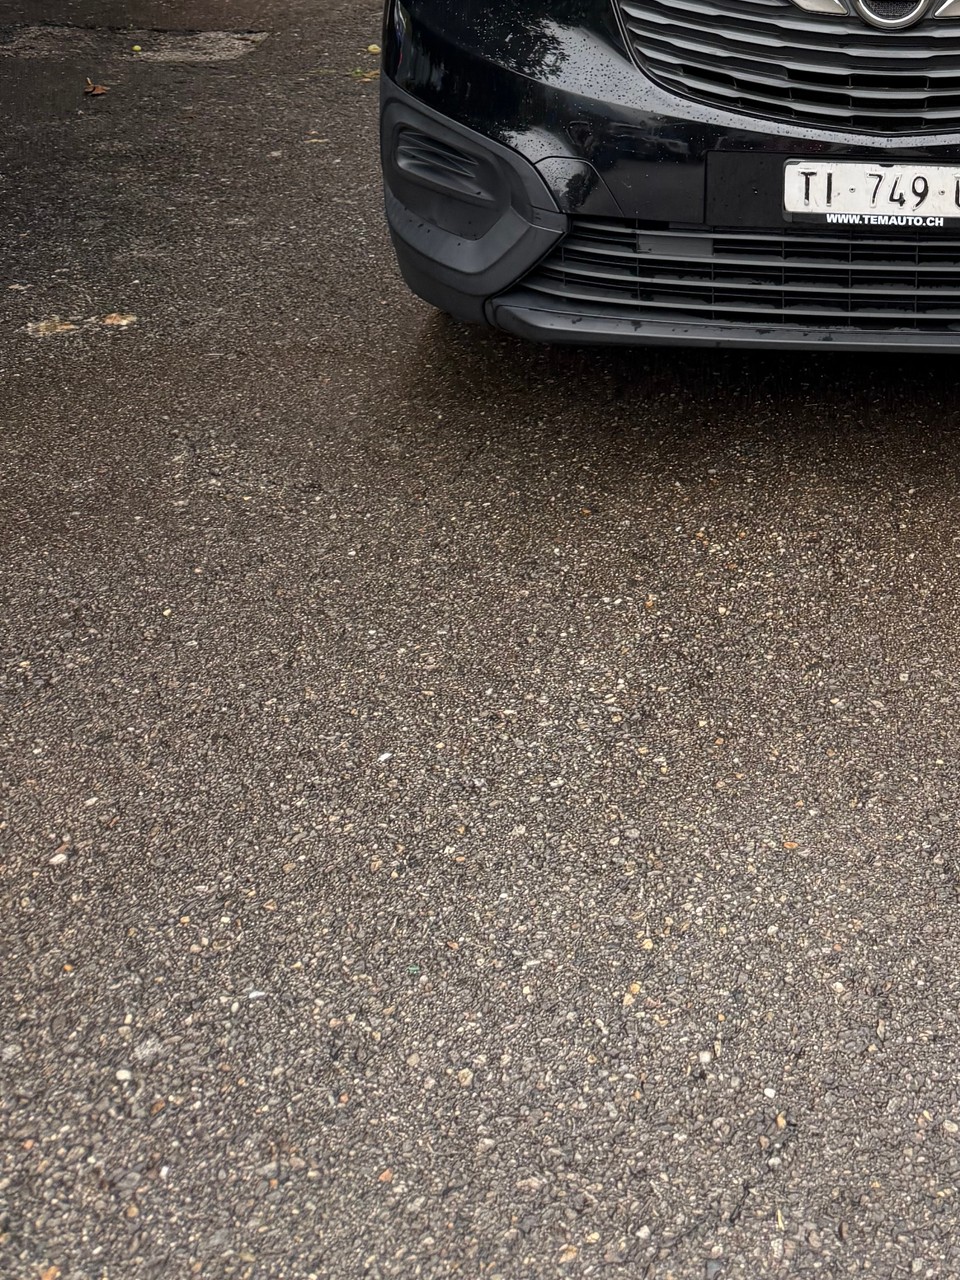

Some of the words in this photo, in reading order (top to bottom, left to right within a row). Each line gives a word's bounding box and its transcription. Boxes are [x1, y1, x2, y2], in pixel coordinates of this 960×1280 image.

[798, 170, 833, 207] TI
[867, 172, 930, 211] 749
[826, 213, 944, 227] WWW.TEMAUTO.CH
